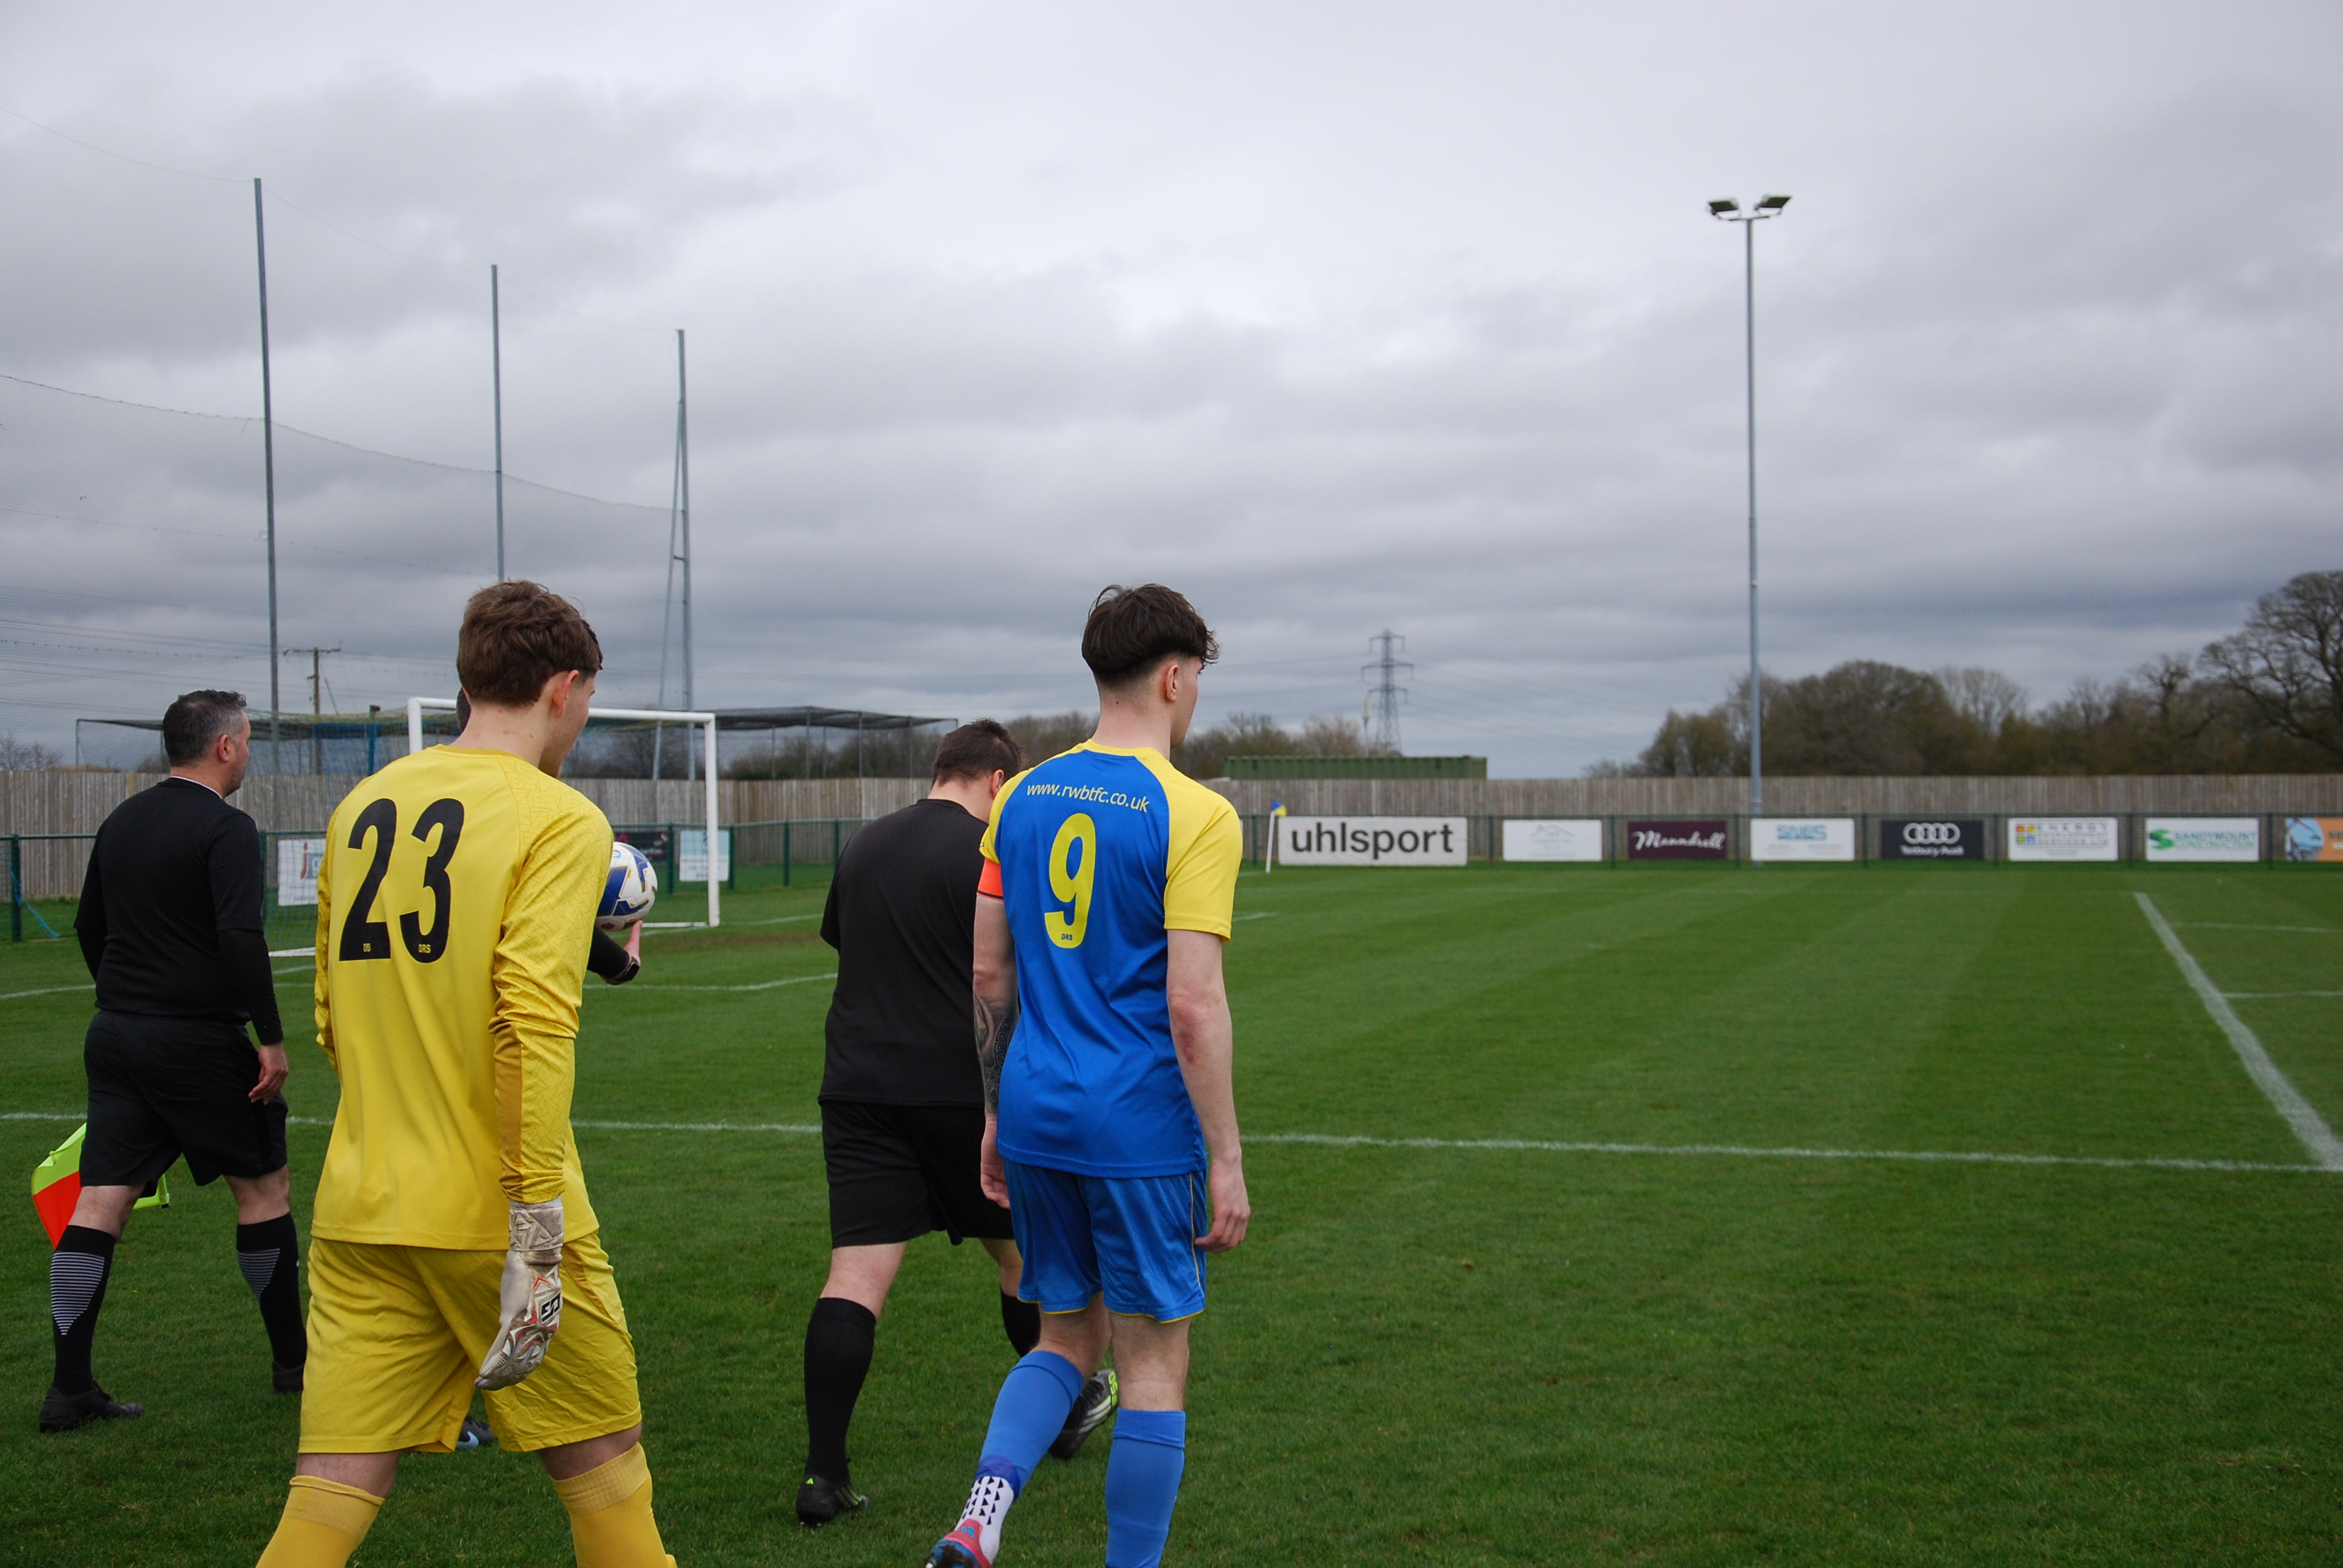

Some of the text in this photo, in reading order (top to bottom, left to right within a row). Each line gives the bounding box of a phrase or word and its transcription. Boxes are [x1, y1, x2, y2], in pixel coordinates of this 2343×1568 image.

[1027, 783, 1150, 813] www.rwbtfc.co.uk
[1292, 822, 1454, 860] uhlsport
[339, 798, 465, 964] 23
[1044, 812, 1096, 949] 9
[418, 944, 431, 953] DRS
